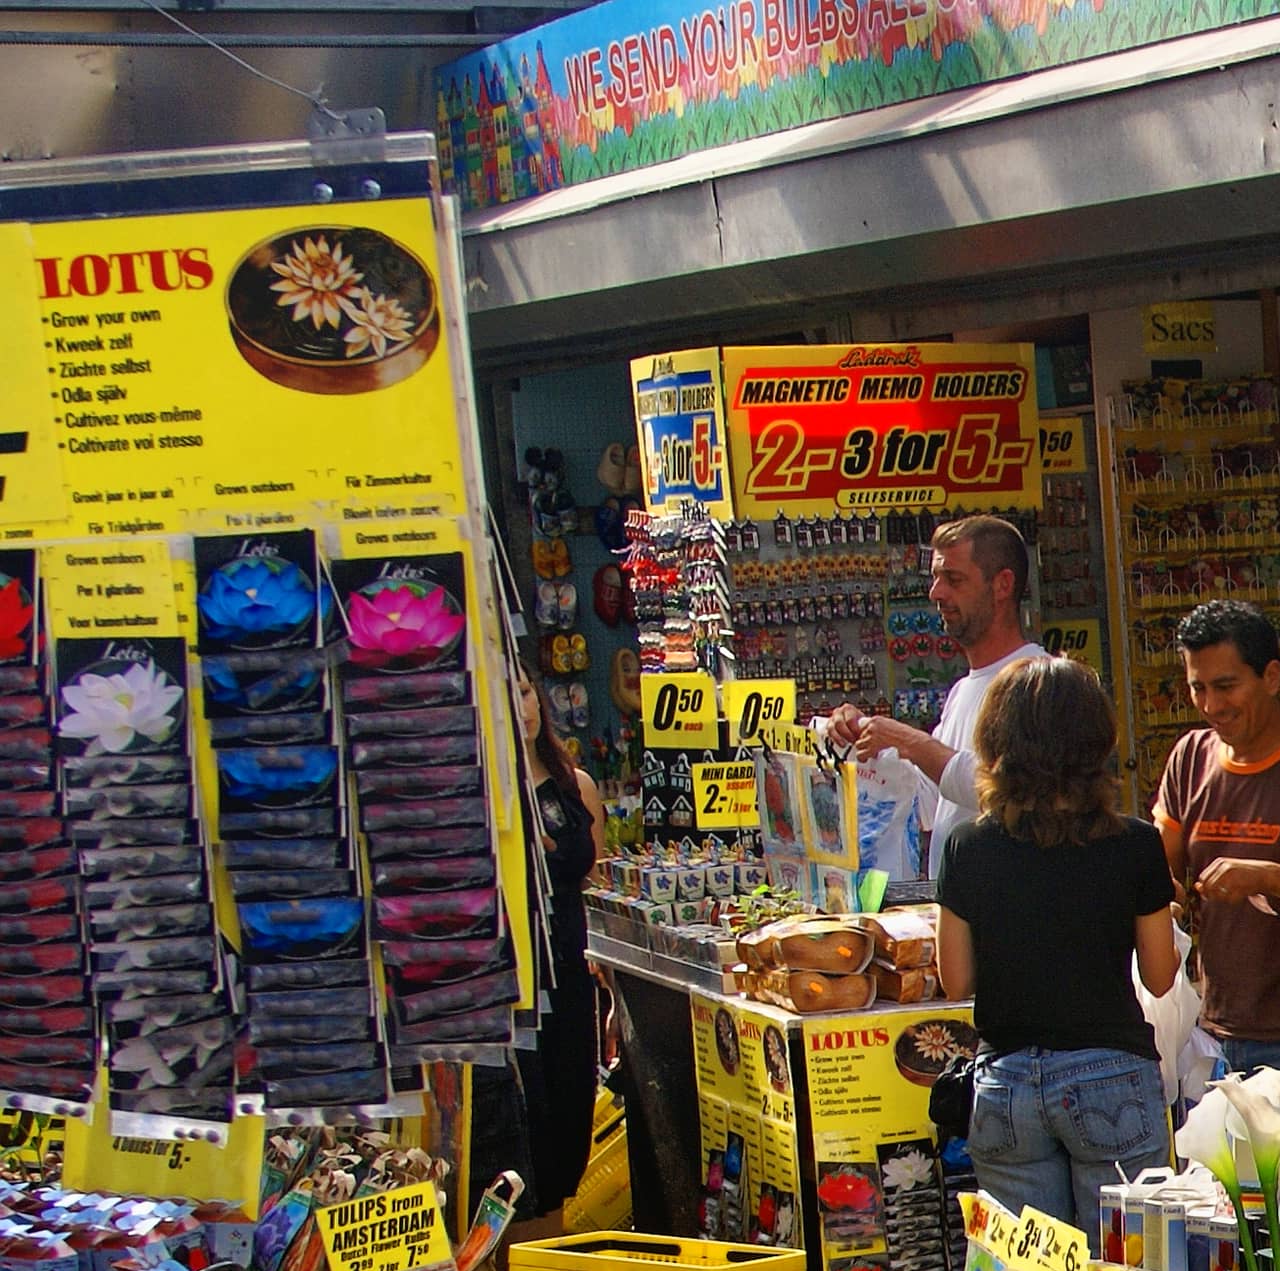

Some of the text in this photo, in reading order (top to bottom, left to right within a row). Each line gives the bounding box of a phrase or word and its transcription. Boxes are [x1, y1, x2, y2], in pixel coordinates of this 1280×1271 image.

[564, 1, 757, 116] WE SEND YOUR
[35, 248, 214, 299] LOTUS
[51, 307, 161, 329] Grow your own
[1151, 315, 1215, 344] Sacs
[56, 335, 133, 352] Kweek zelf
[60, 359, 151, 378] Züchte selbst
[62, 387, 92, 404] Odla
[741, 370, 1024, 405] MAGNETIC MEMO HOLDERS
[66, 412, 119, 429] Cultivez
[69, 433, 203, 454] Coltivate voi stesso
[842, 427, 948, 477] 3 for
[848, 489, 935, 505] SELFSERVICE
[653, 684, 704, 731] 0.50
[701, 767, 724, 782] MINI
[811, 1027, 891, 1052] LOTUS
[168, 1142, 191, 1170] 5.-
[327, 1191, 424, 1228] TULIPS from
[332, 1207, 436, 1254] AMSTERDAM
[341, 1229, 432, 1263] Dutch Flower Bulbs
[406, 1242, 431, 1269] 7.50
